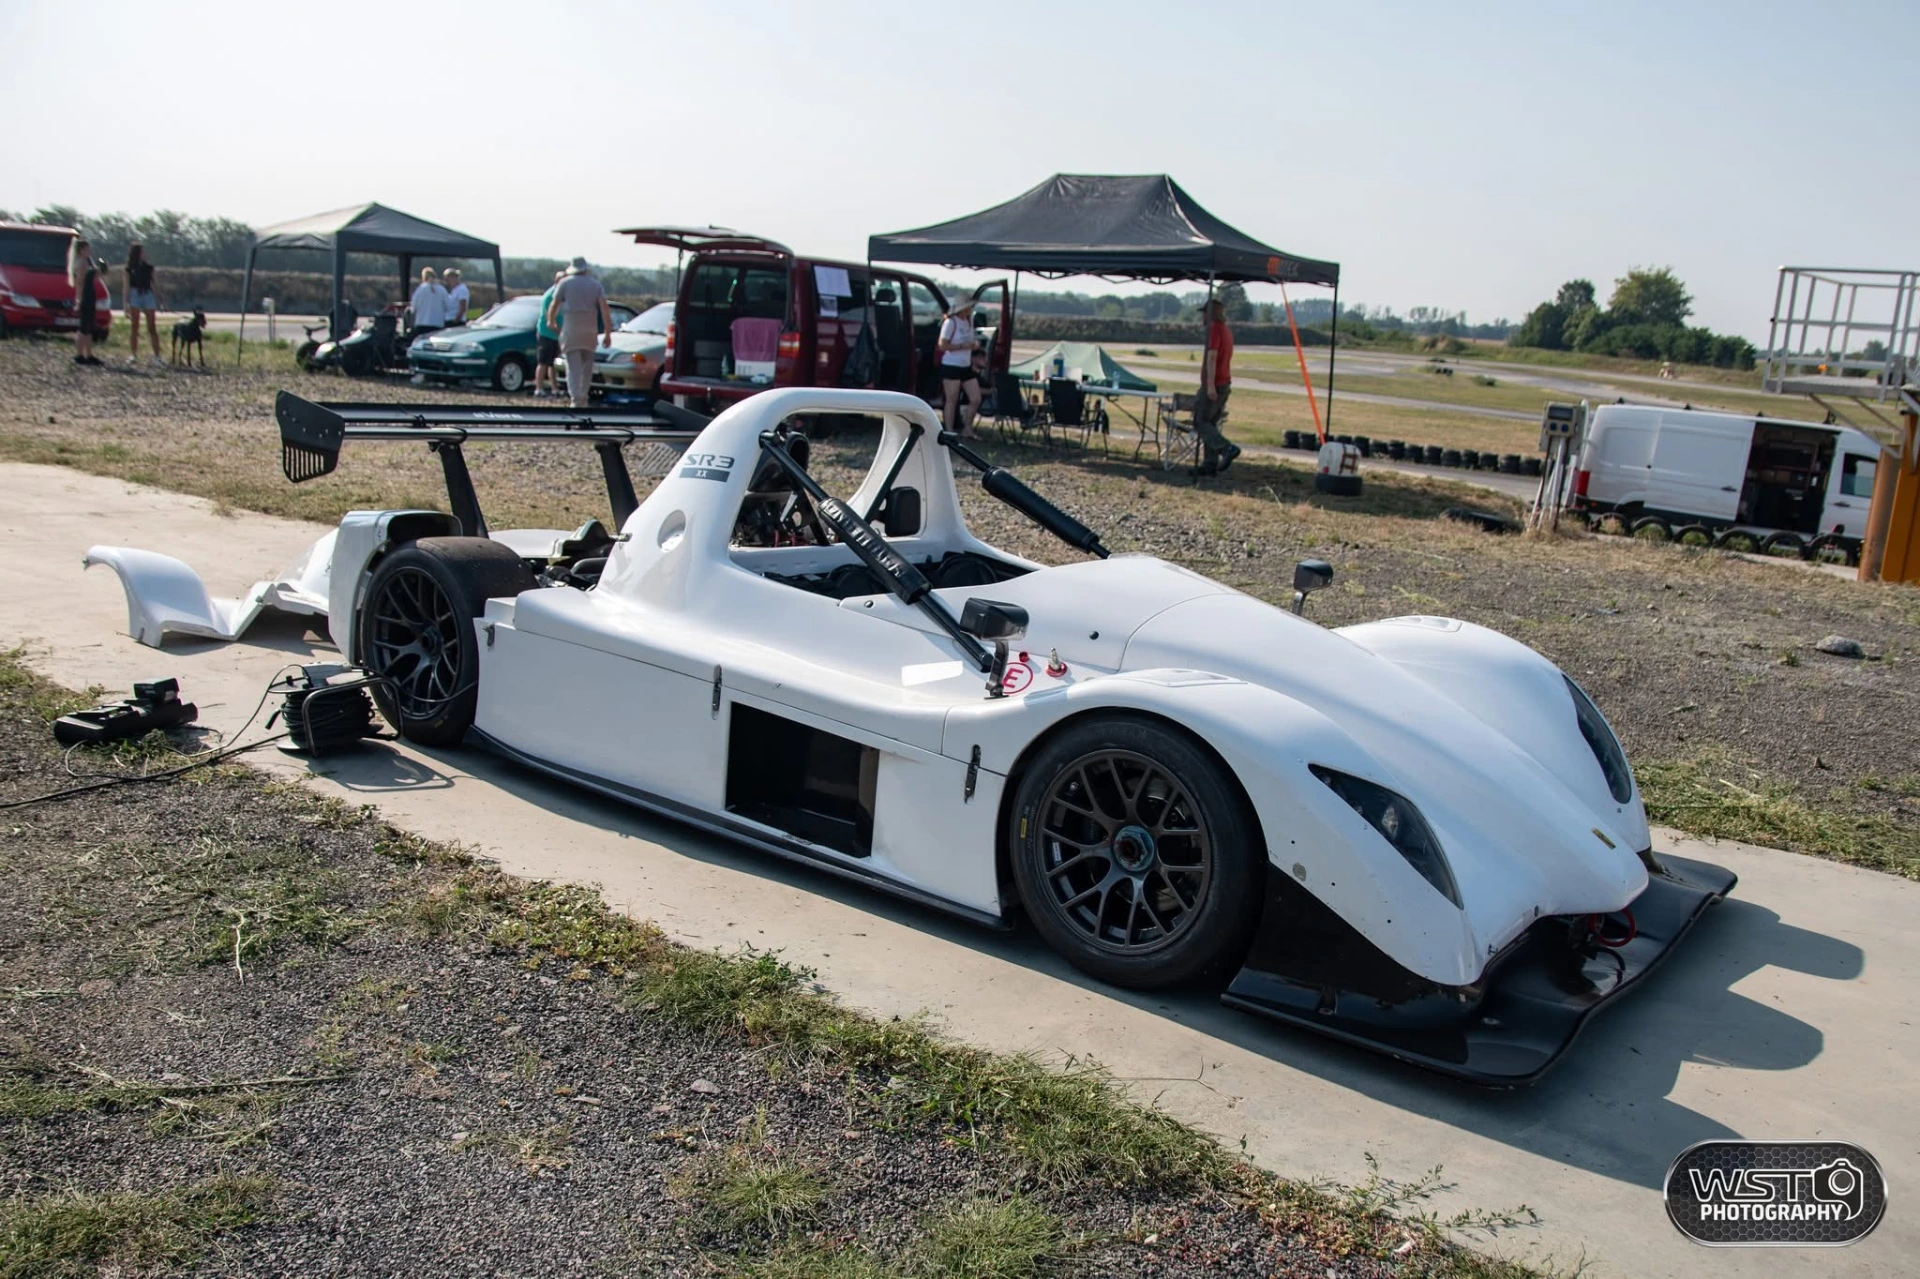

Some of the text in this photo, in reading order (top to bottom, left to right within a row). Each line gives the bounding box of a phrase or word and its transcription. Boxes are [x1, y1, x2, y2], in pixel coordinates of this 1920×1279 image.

[684, 453, 736, 469] SR3
[695, 469, 708, 478] XX
[1002, 667, 1024, 689] E
